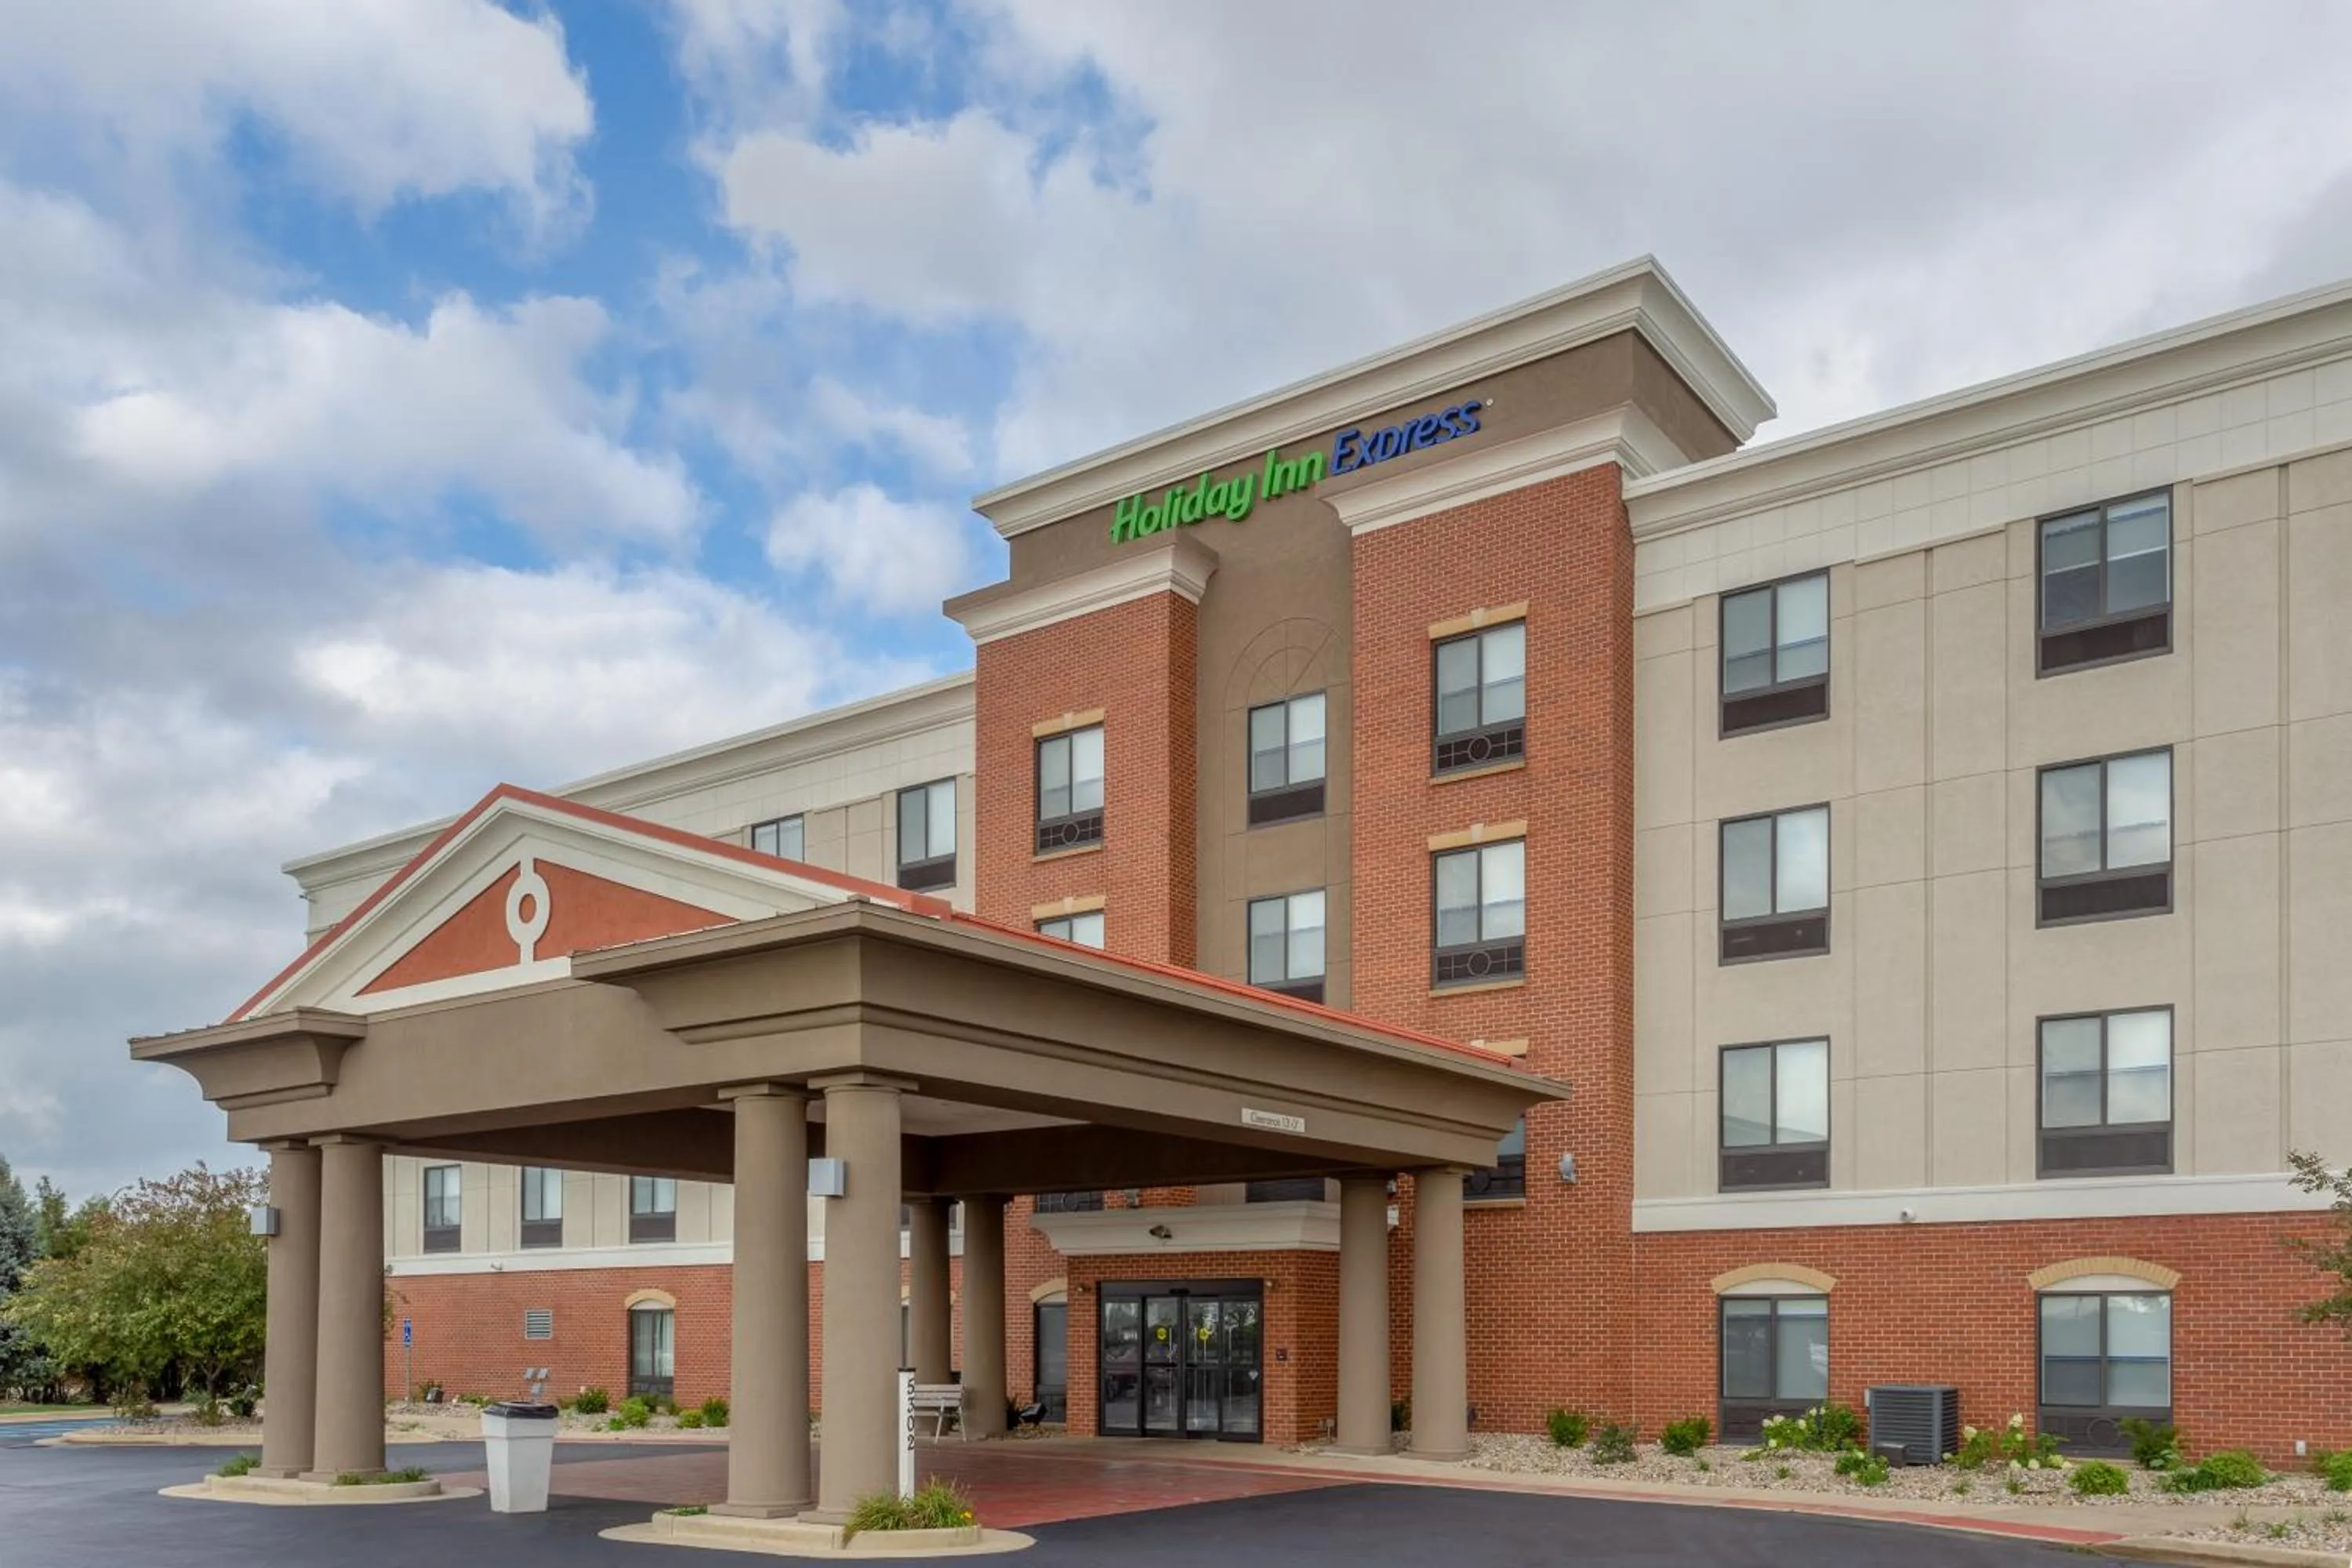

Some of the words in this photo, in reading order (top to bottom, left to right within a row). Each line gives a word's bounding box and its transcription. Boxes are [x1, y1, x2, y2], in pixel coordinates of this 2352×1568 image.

[1109, 470, 1257, 543] Holiday
[1261, 449, 1327, 500] Inn
[1330, 401, 1482, 476] Express
[906, 1378, 915, 1450] 5302
